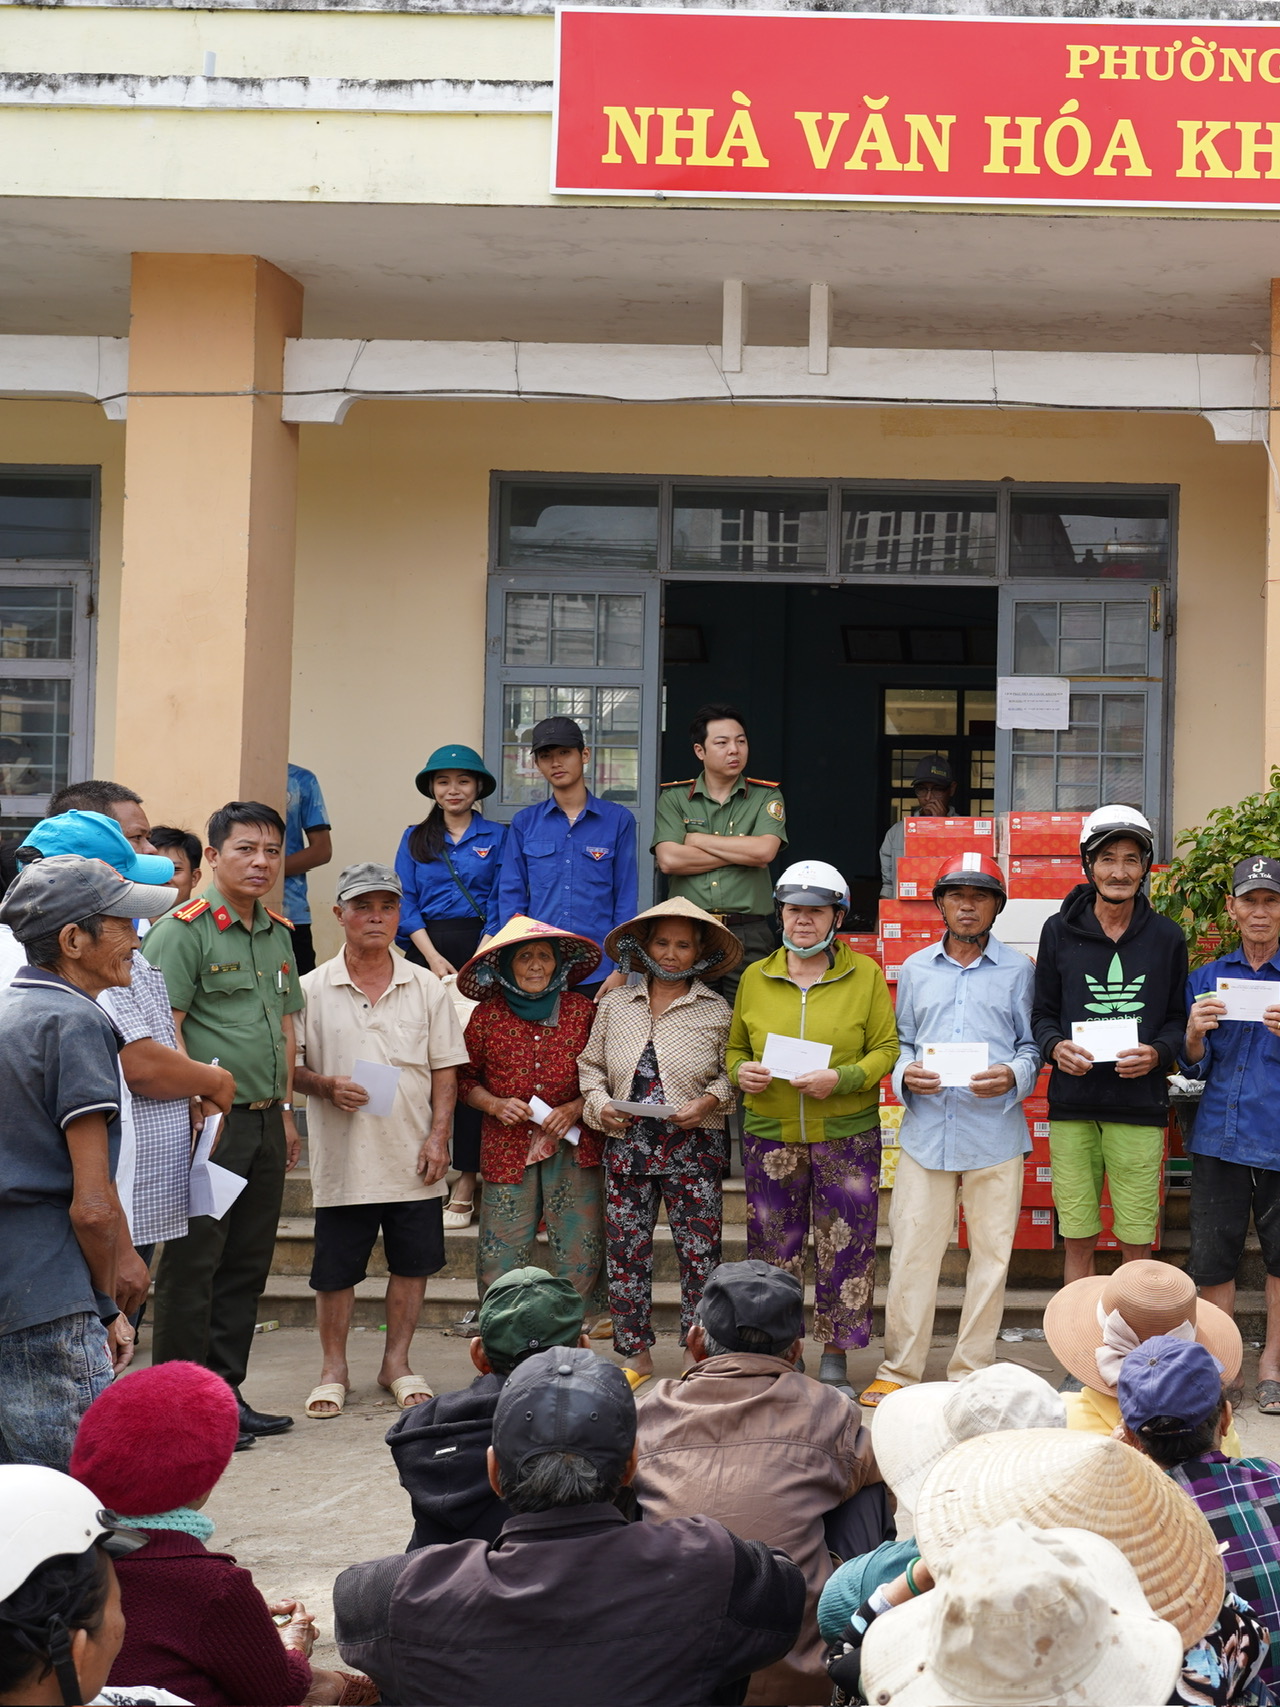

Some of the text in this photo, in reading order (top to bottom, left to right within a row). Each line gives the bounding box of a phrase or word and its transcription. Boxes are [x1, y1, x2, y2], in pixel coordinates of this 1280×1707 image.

[601, 90, 769, 168] NHÀ
[794, 95, 957, 172] VĂN
[983, 99, 1152, 177] HÓA
